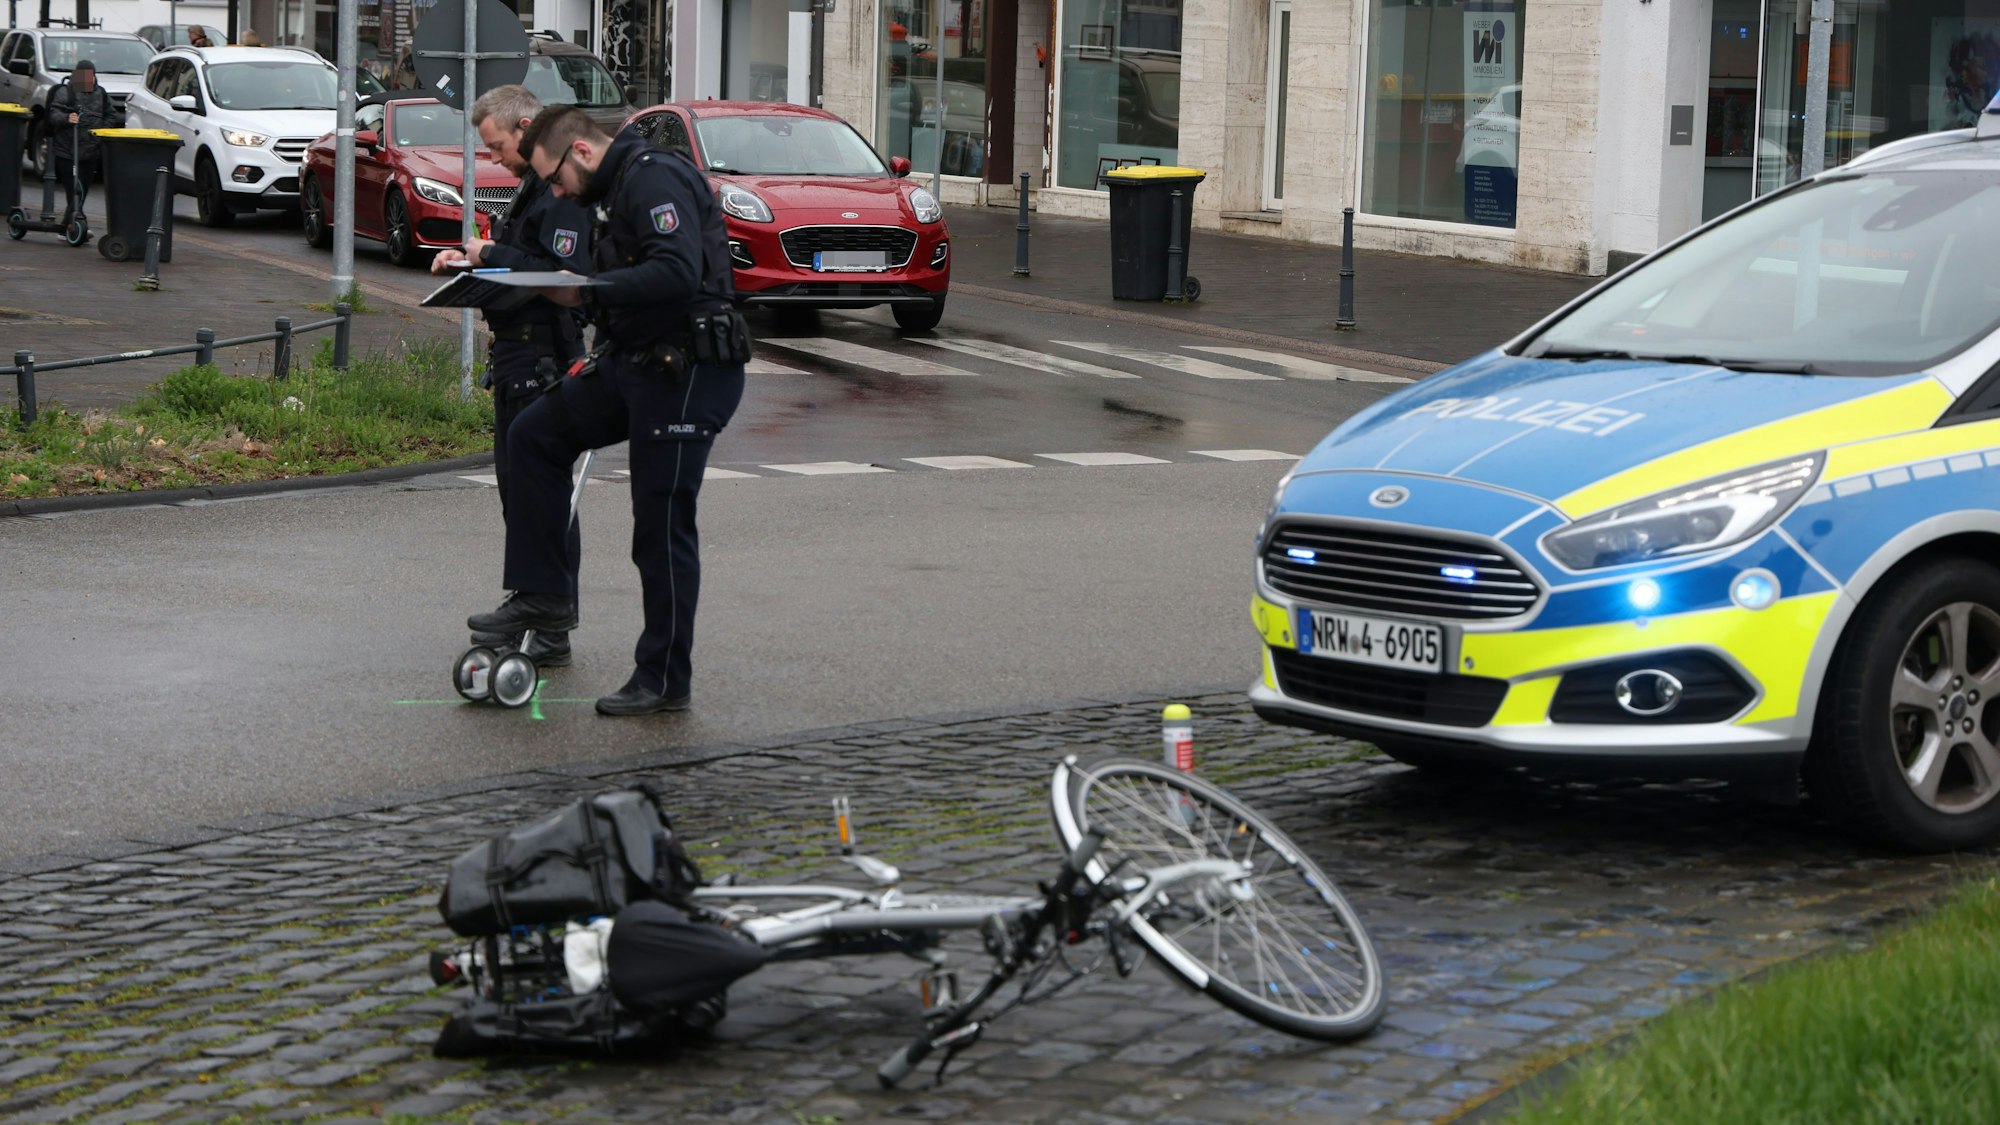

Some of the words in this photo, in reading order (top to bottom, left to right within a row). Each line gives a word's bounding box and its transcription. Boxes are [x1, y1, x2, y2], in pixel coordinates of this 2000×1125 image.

[668, 423, 696, 433] POLIZEI
[1397, 396, 1646, 436] POLIZEI
[1312, 614, 1348, 653] NRW
[1361, 622, 1438, 664] 4-6905
